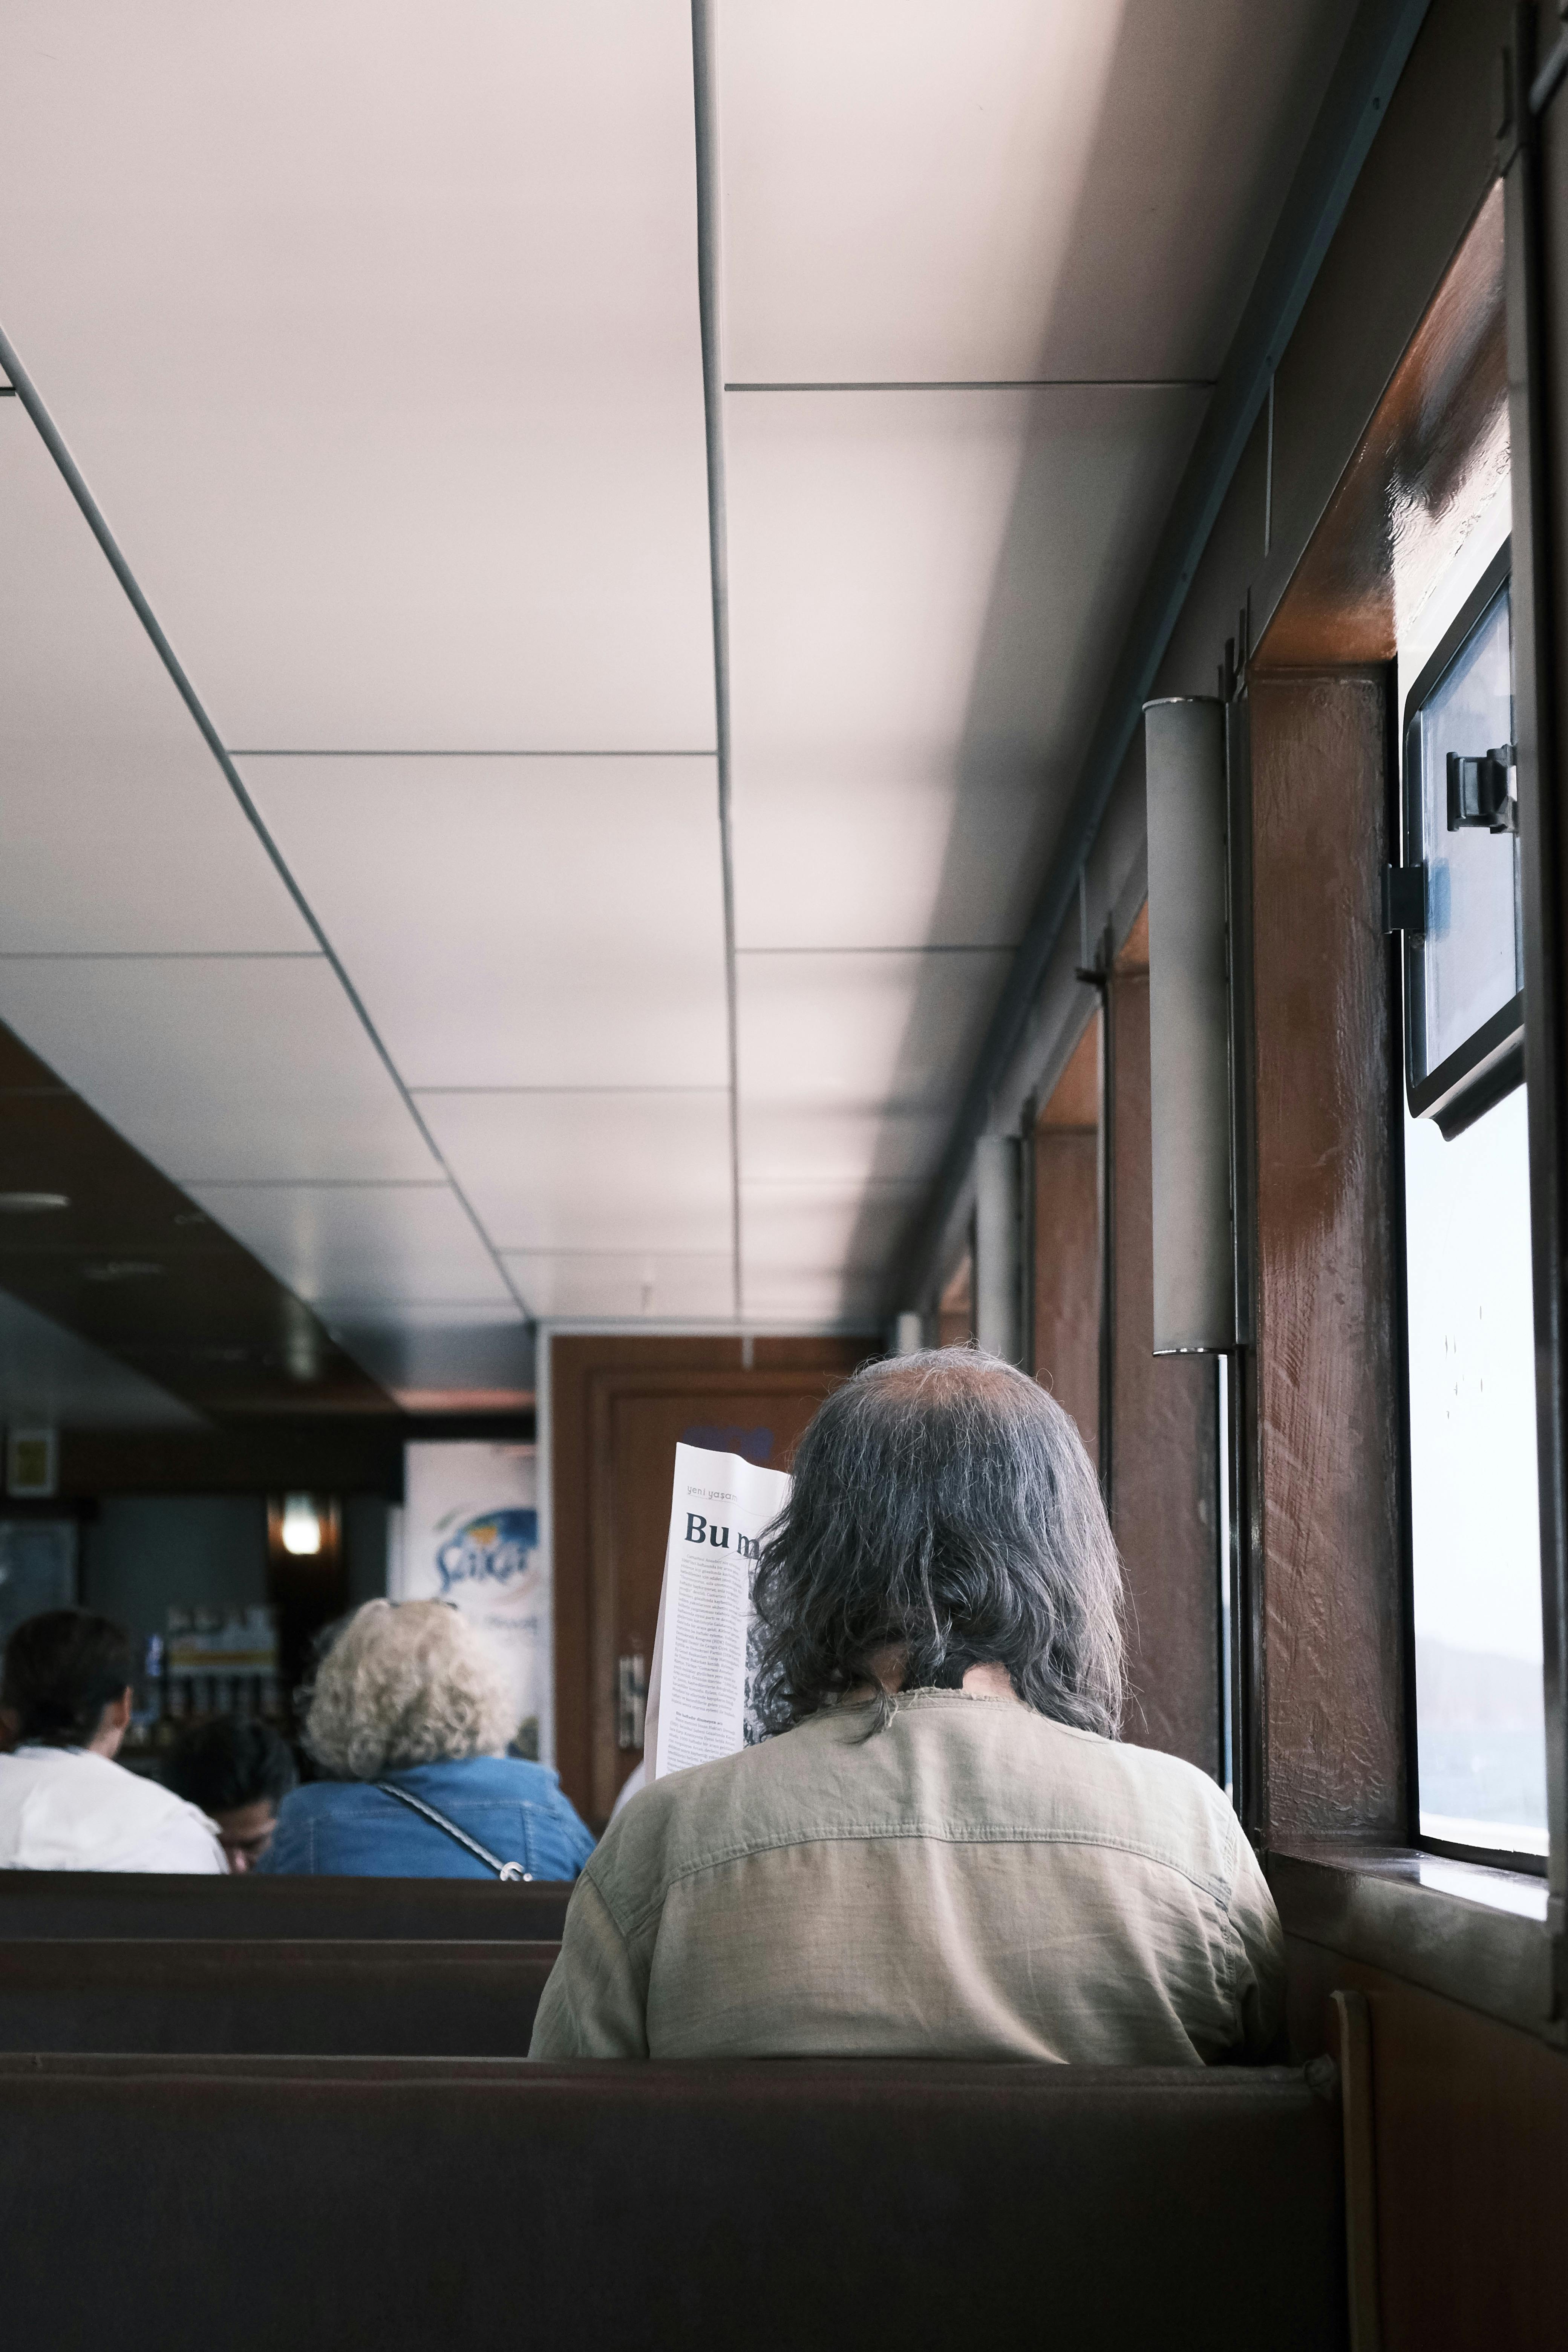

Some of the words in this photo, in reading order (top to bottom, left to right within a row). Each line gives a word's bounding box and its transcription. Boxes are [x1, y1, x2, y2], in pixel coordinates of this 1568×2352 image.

[688, 1485, 705, 1495] yeni
[709, 1491, 737, 1502] yaşam
[684, 1512, 729, 1549] Bu
